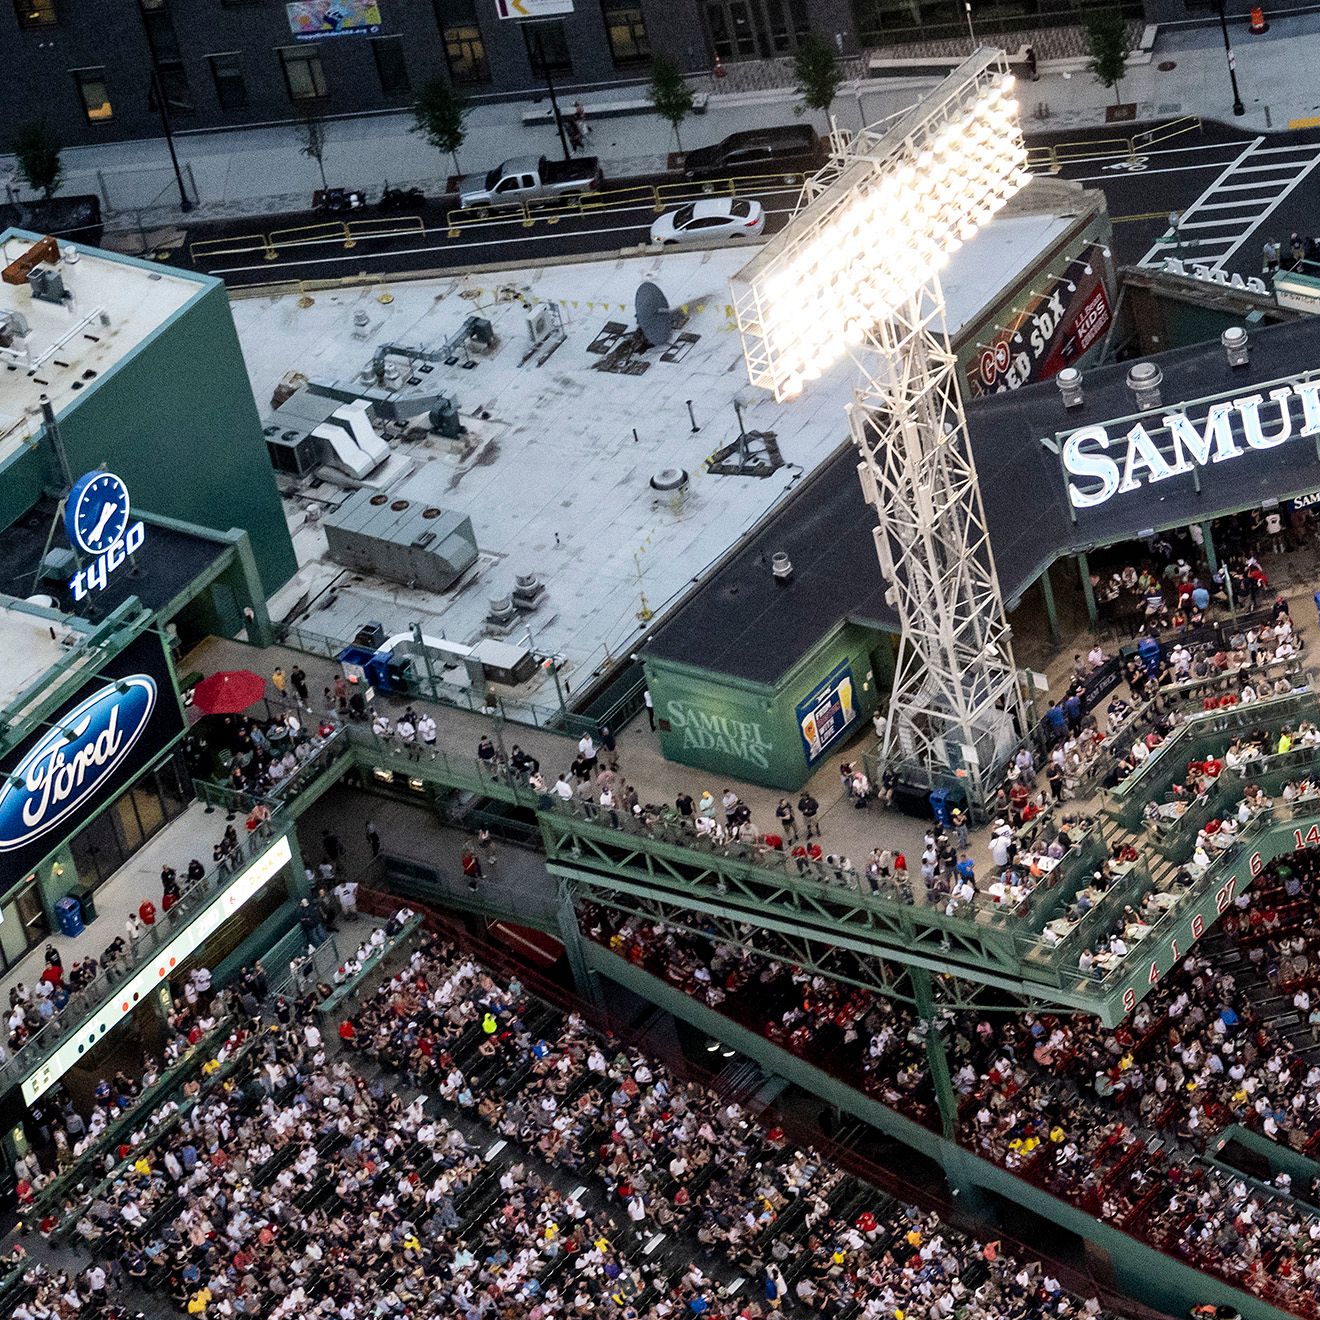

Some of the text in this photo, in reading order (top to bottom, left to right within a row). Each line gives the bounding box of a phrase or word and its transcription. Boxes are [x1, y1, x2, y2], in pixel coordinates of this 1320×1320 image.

[1031, 289, 1065, 359] SOX
[1077, 300, 1106, 338] KIDS
[980, 341, 1010, 386] GO
[69, 521, 145, 602] tyco
[667, 700, 773, 751] SAMUEL
[683, 727, 769, 769] ADAMS
[22, 704, 123, 827] Ford
[1214, 875, 1239, 914] 27
[1249, 851, 1263, 877] 6
